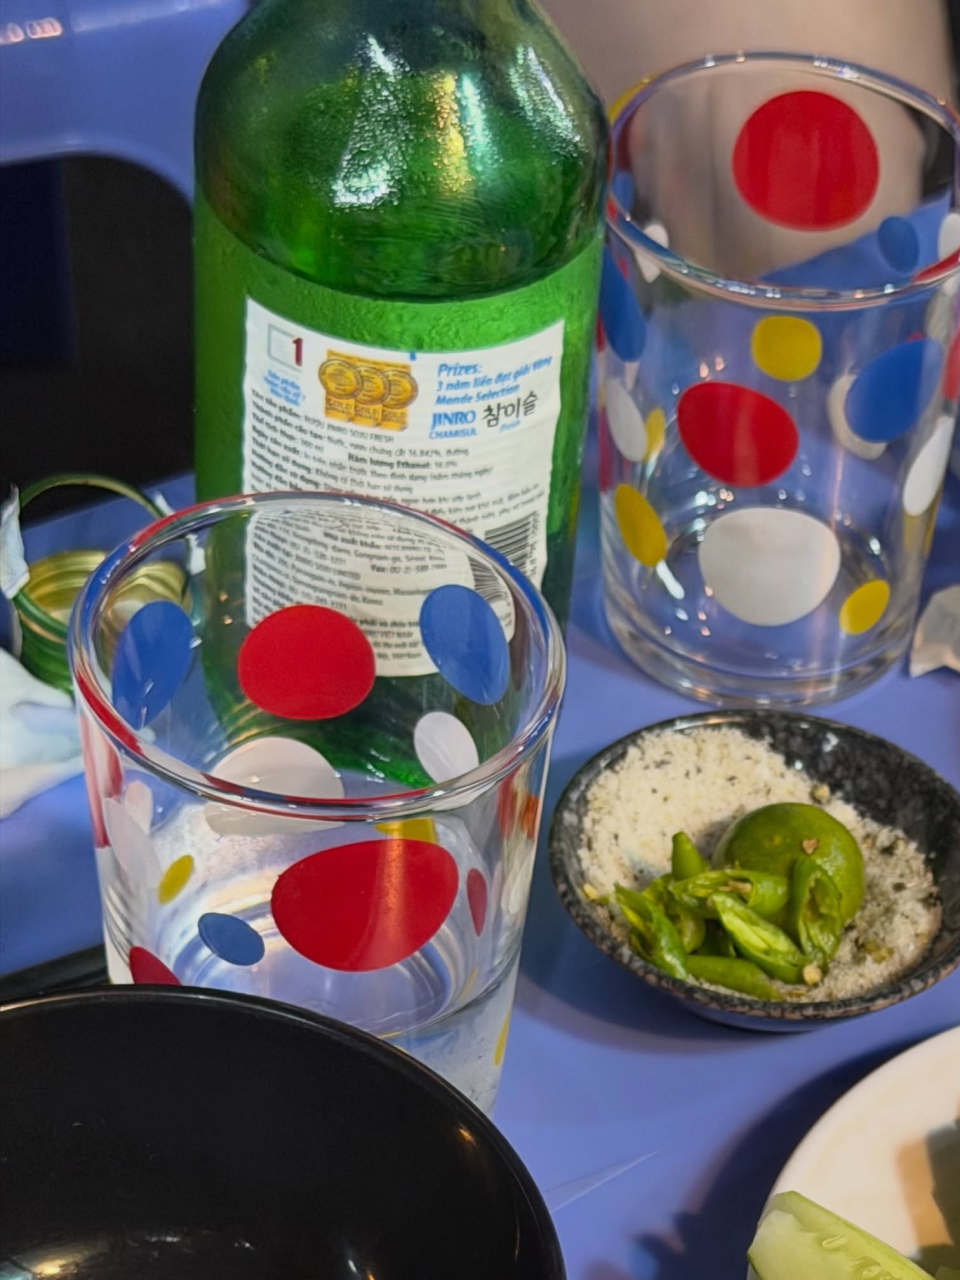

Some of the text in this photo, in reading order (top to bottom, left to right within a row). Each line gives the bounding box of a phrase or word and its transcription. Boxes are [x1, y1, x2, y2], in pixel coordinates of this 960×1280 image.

[438, 363, 482, 377] Prizes:
[436, 384, 520, 405] Monde Selection
[437, 381, 443, 391] 3
[481, 391, 539, 428] 참이슬
[431, 409, 477, 429] JINRO
[429, 428, 477, 439] CHAMISUL
